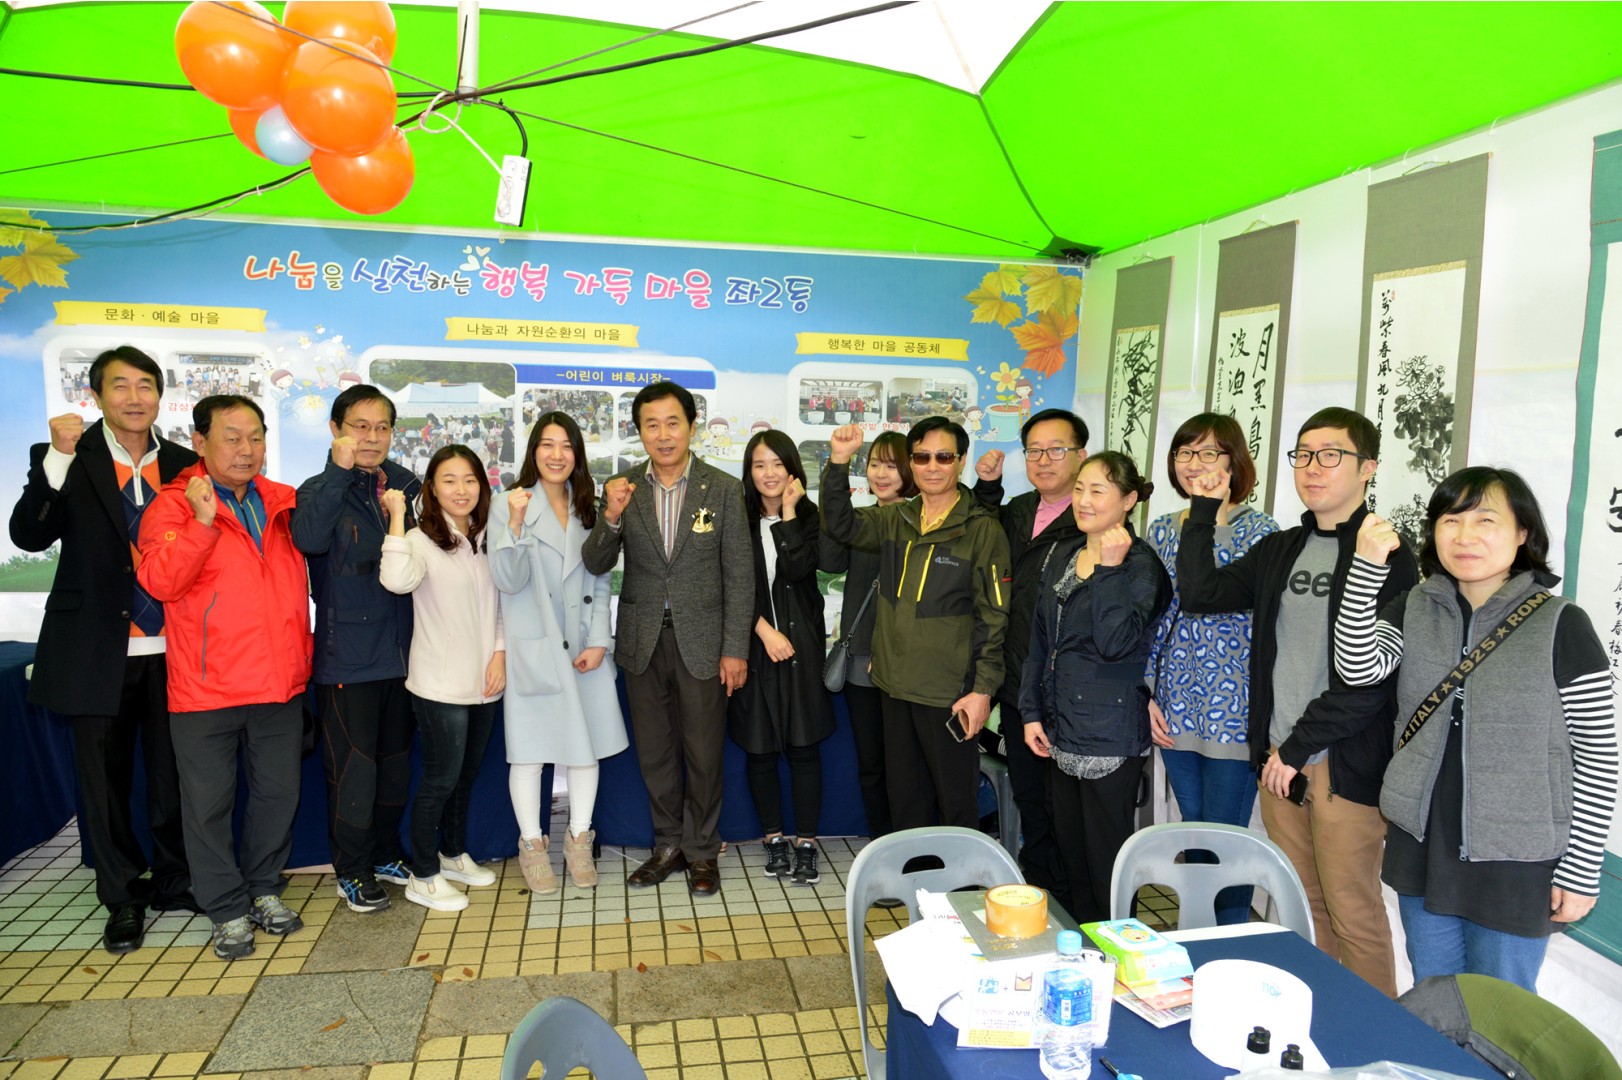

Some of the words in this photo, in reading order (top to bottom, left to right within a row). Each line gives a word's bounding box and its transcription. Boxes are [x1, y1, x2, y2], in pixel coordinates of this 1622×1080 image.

[244, 251, 344, 290] 나눔을
[351, 255, 471, 295] 실천하는
[480, 262, 549, 302] 행복
[564, 267, 633, 304] 가득
[645, 269, 712, 309] 마을
[725, 275, 813, 313] 좌2동
[104, 309, 135, 321] 문화
[152, 310, 181, 323] 예술
[191, 312, 220, 324] 마을
[467, 323, 508, 337] 나눔과
[517, 325, 586, 339] 자원순환의
[594, 328, 621, 341] 마을
[828, 338, 865, 351] 행복한
[873, 340, 896, 352] 마을
[904, 341, 940, 354] 공동체
[1408, 691, 1443, 733] ITALY
[1450, 637, 1496, 680] 1925
